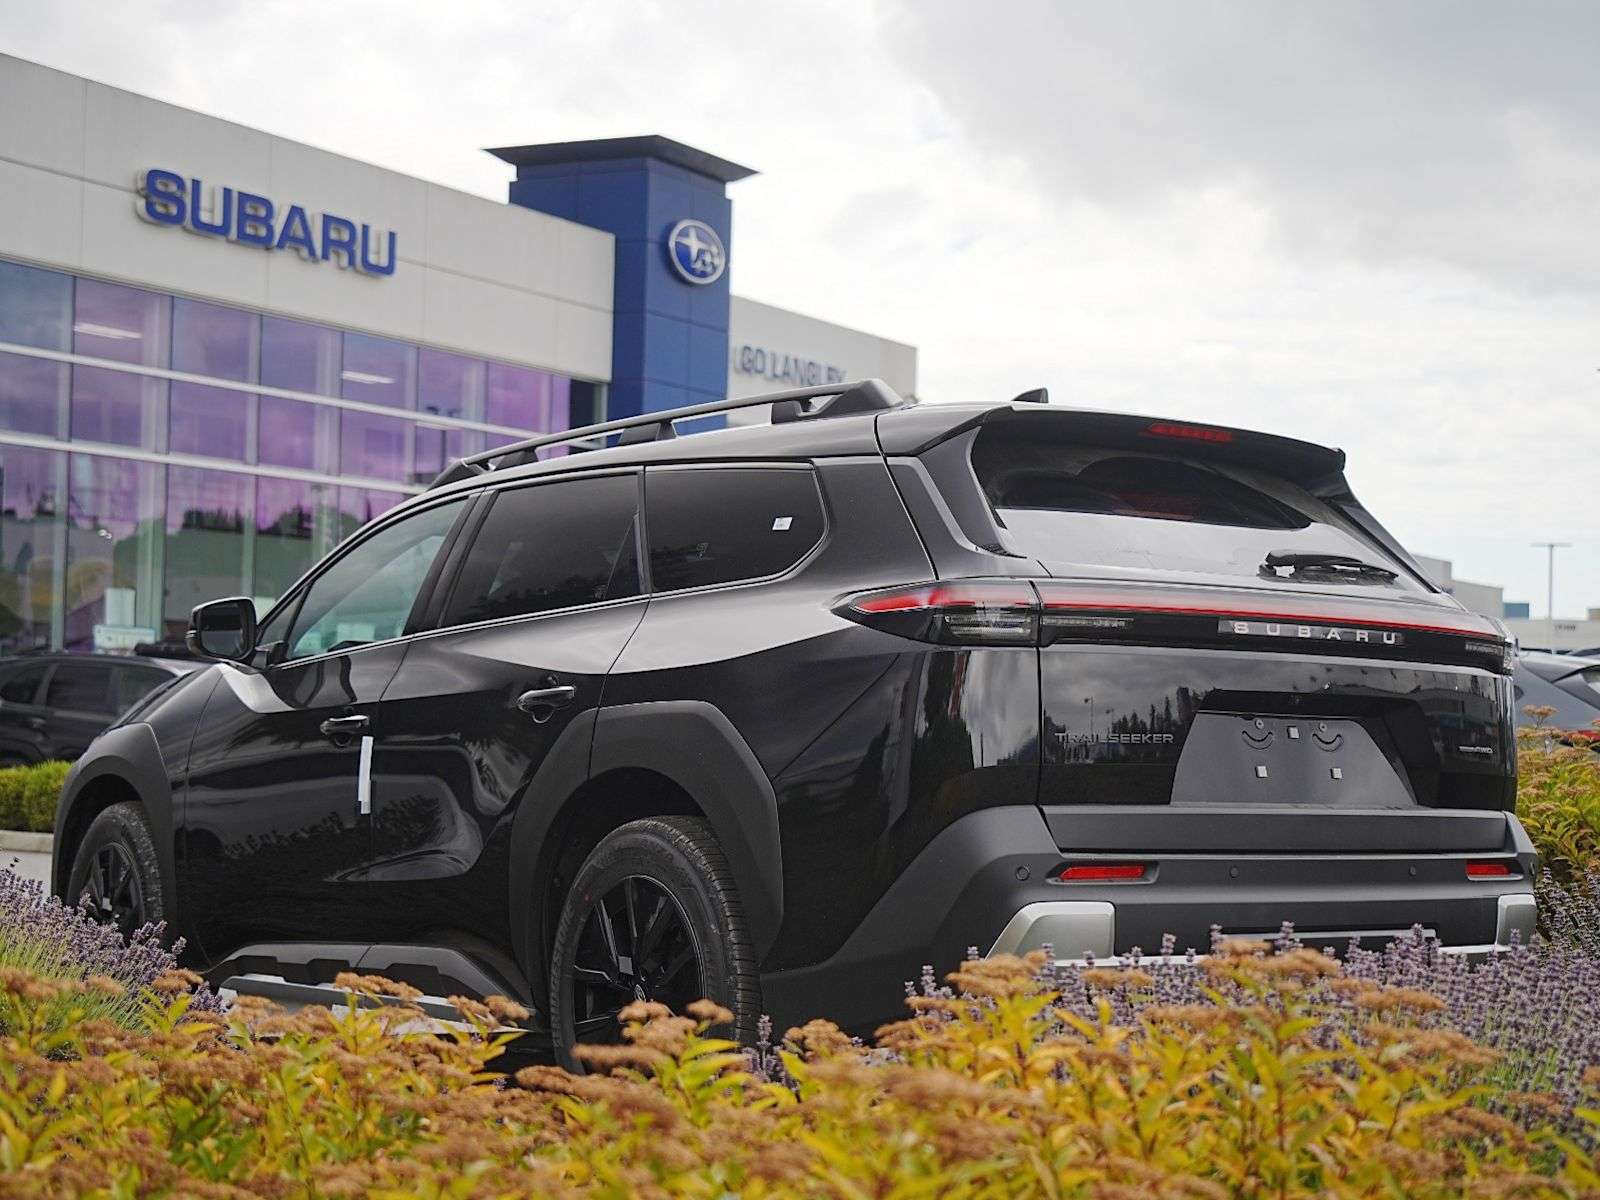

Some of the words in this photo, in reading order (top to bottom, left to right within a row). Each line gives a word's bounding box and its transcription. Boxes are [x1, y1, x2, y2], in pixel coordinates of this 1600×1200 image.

[143, 168, 398, 277] SUBARU
[1233, 621, 1397, 645] SUBARU
[1054, 731, 1175, 744] TRAILSEEKER
